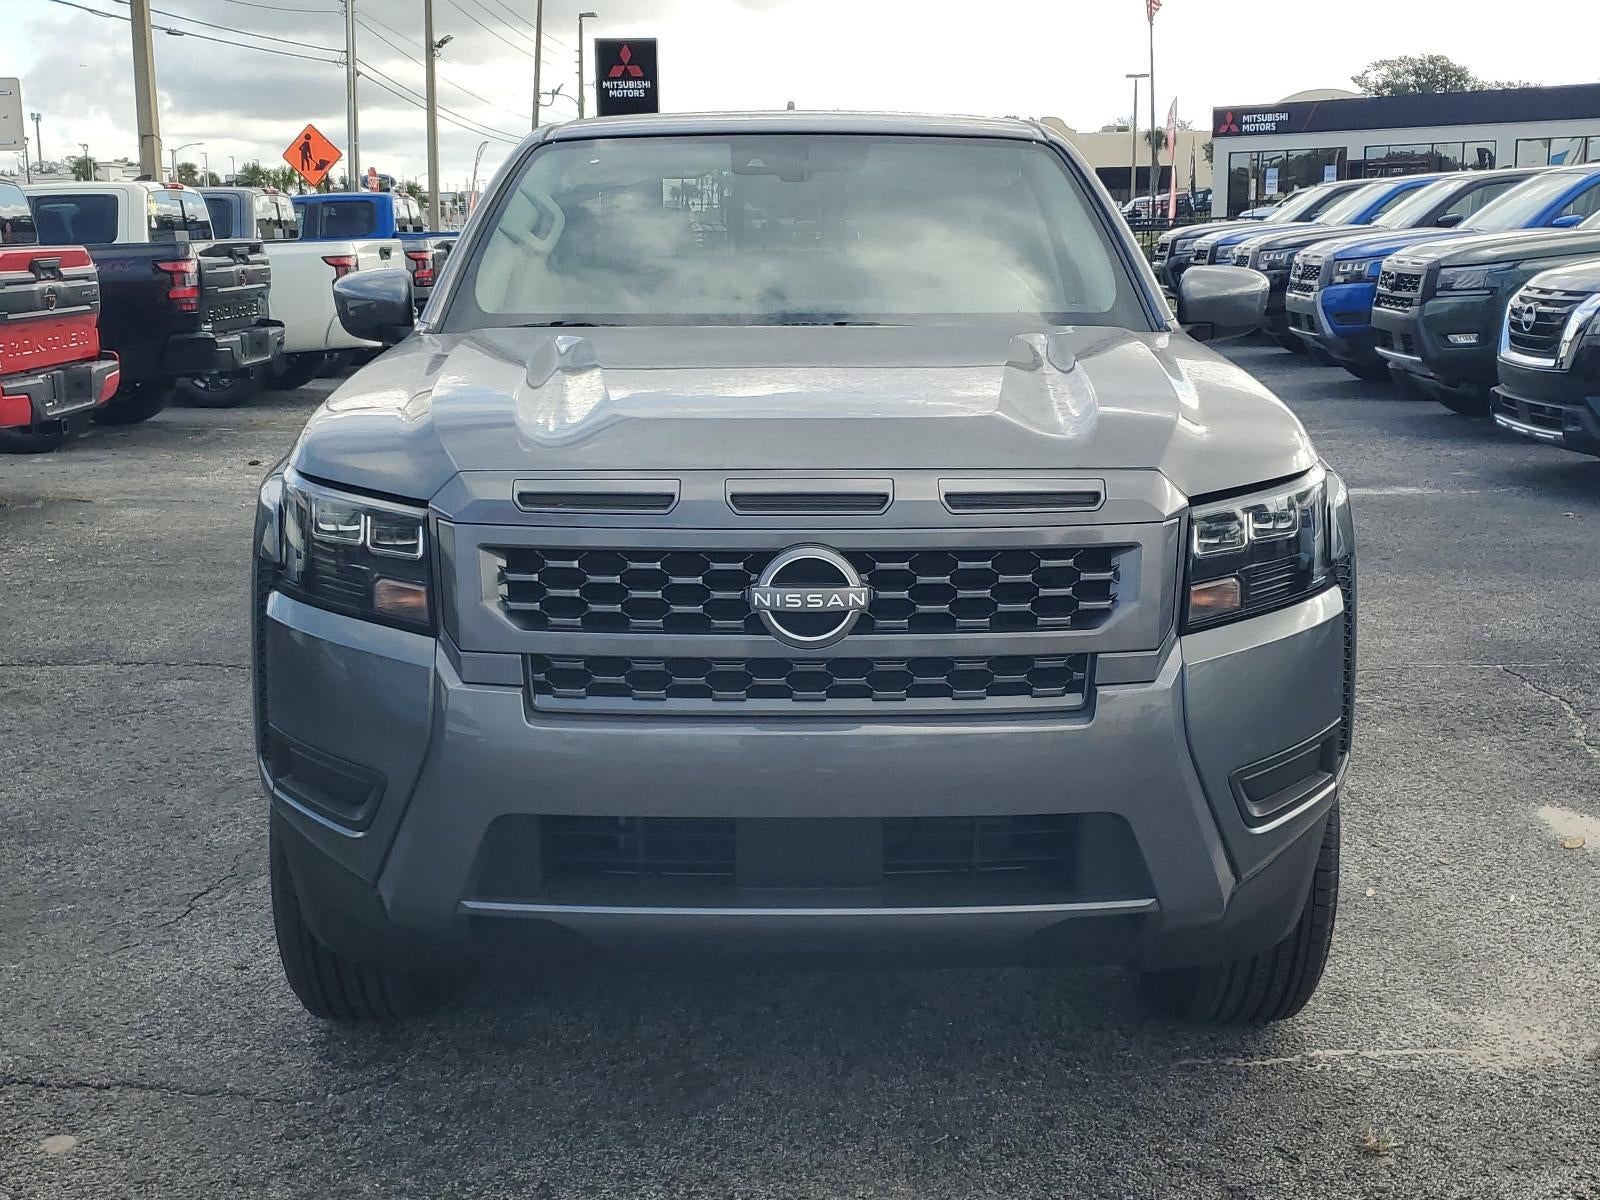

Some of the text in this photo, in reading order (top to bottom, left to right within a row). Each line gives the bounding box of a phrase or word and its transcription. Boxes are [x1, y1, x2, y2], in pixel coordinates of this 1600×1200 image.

[602, 80, 651, 89] MITSUBISHI
[609, 89, 645, 98] MOTORS
[1242, 112, 1289, 123] MITSUBISHI
[1242, 122, 1276, 132] MOTORS
[753, 592, 865, 608] NISSAN
